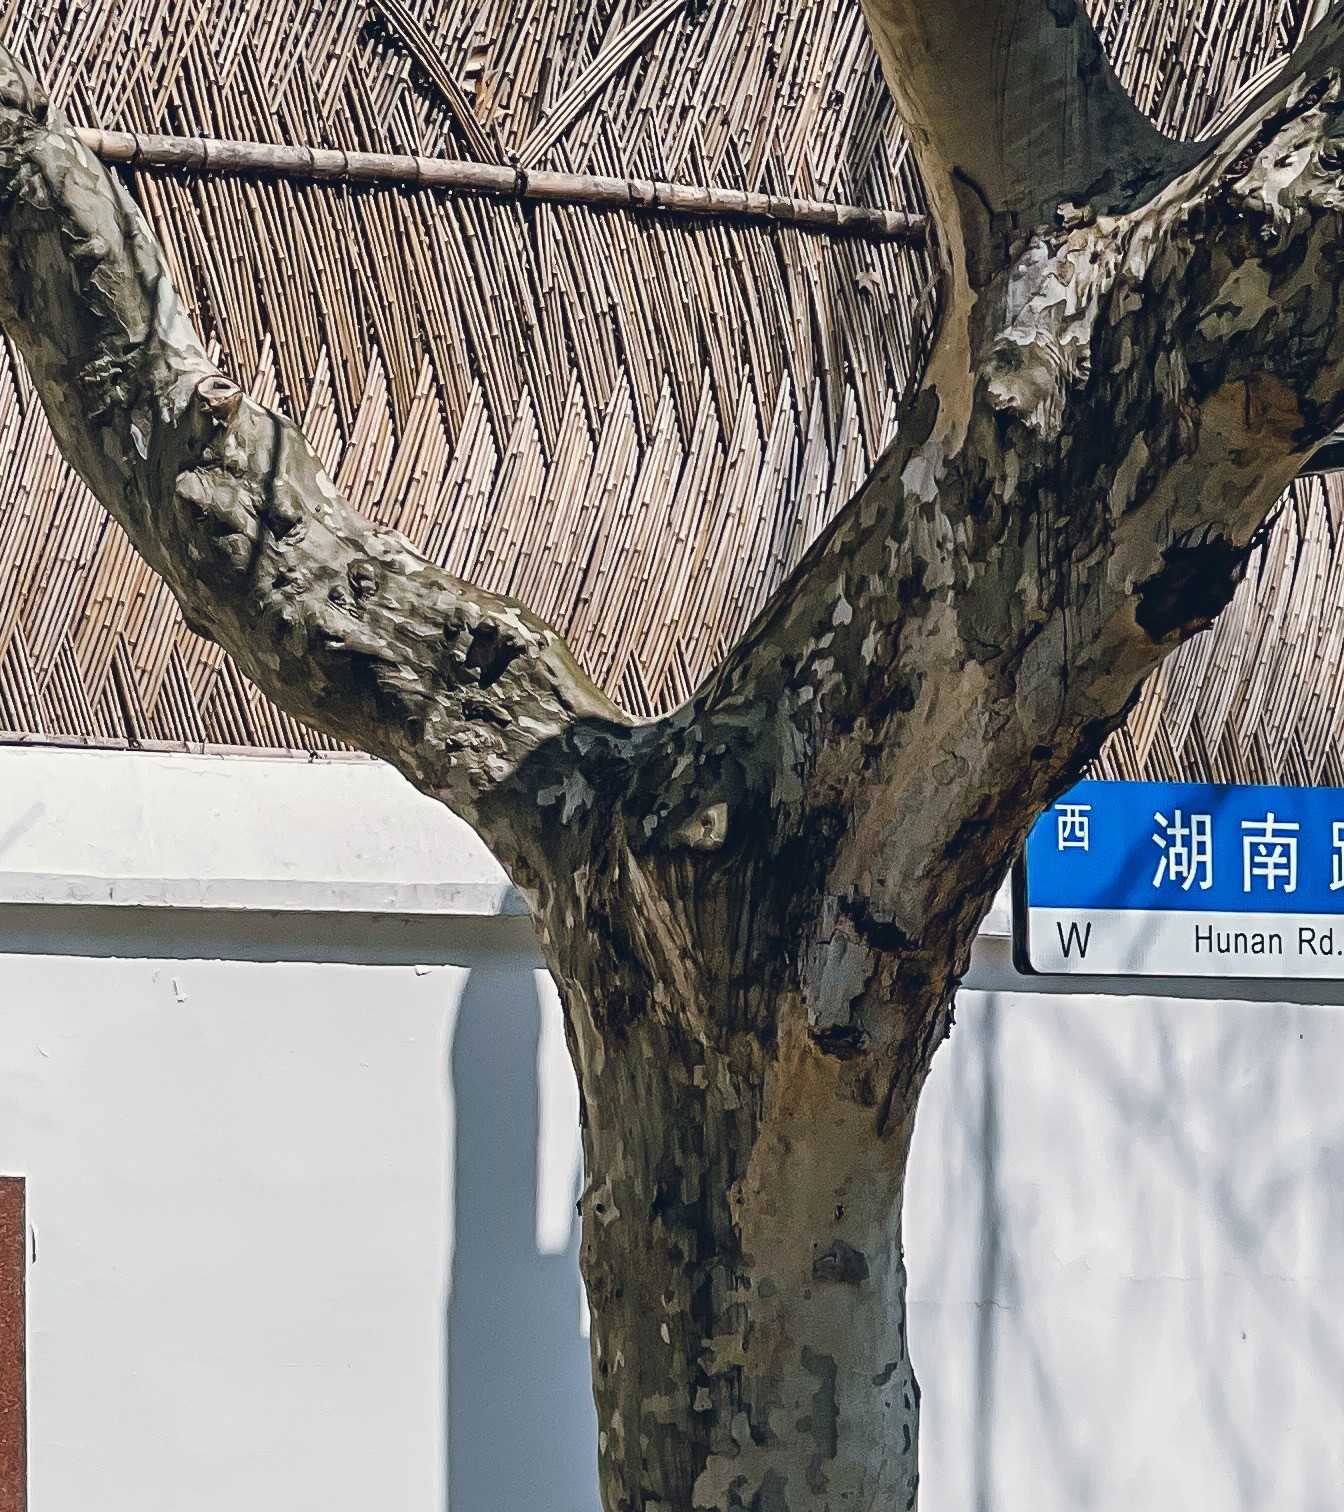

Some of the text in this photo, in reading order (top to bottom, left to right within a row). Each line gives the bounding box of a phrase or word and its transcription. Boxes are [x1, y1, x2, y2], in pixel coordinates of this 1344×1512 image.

[1054, 803, 1092, 852] 西
[1151, 809, 1344, 894] 湖南
[1056, 921, 1092, 959] W
[1194, 924, 1343, 956] Hunan Rd.
